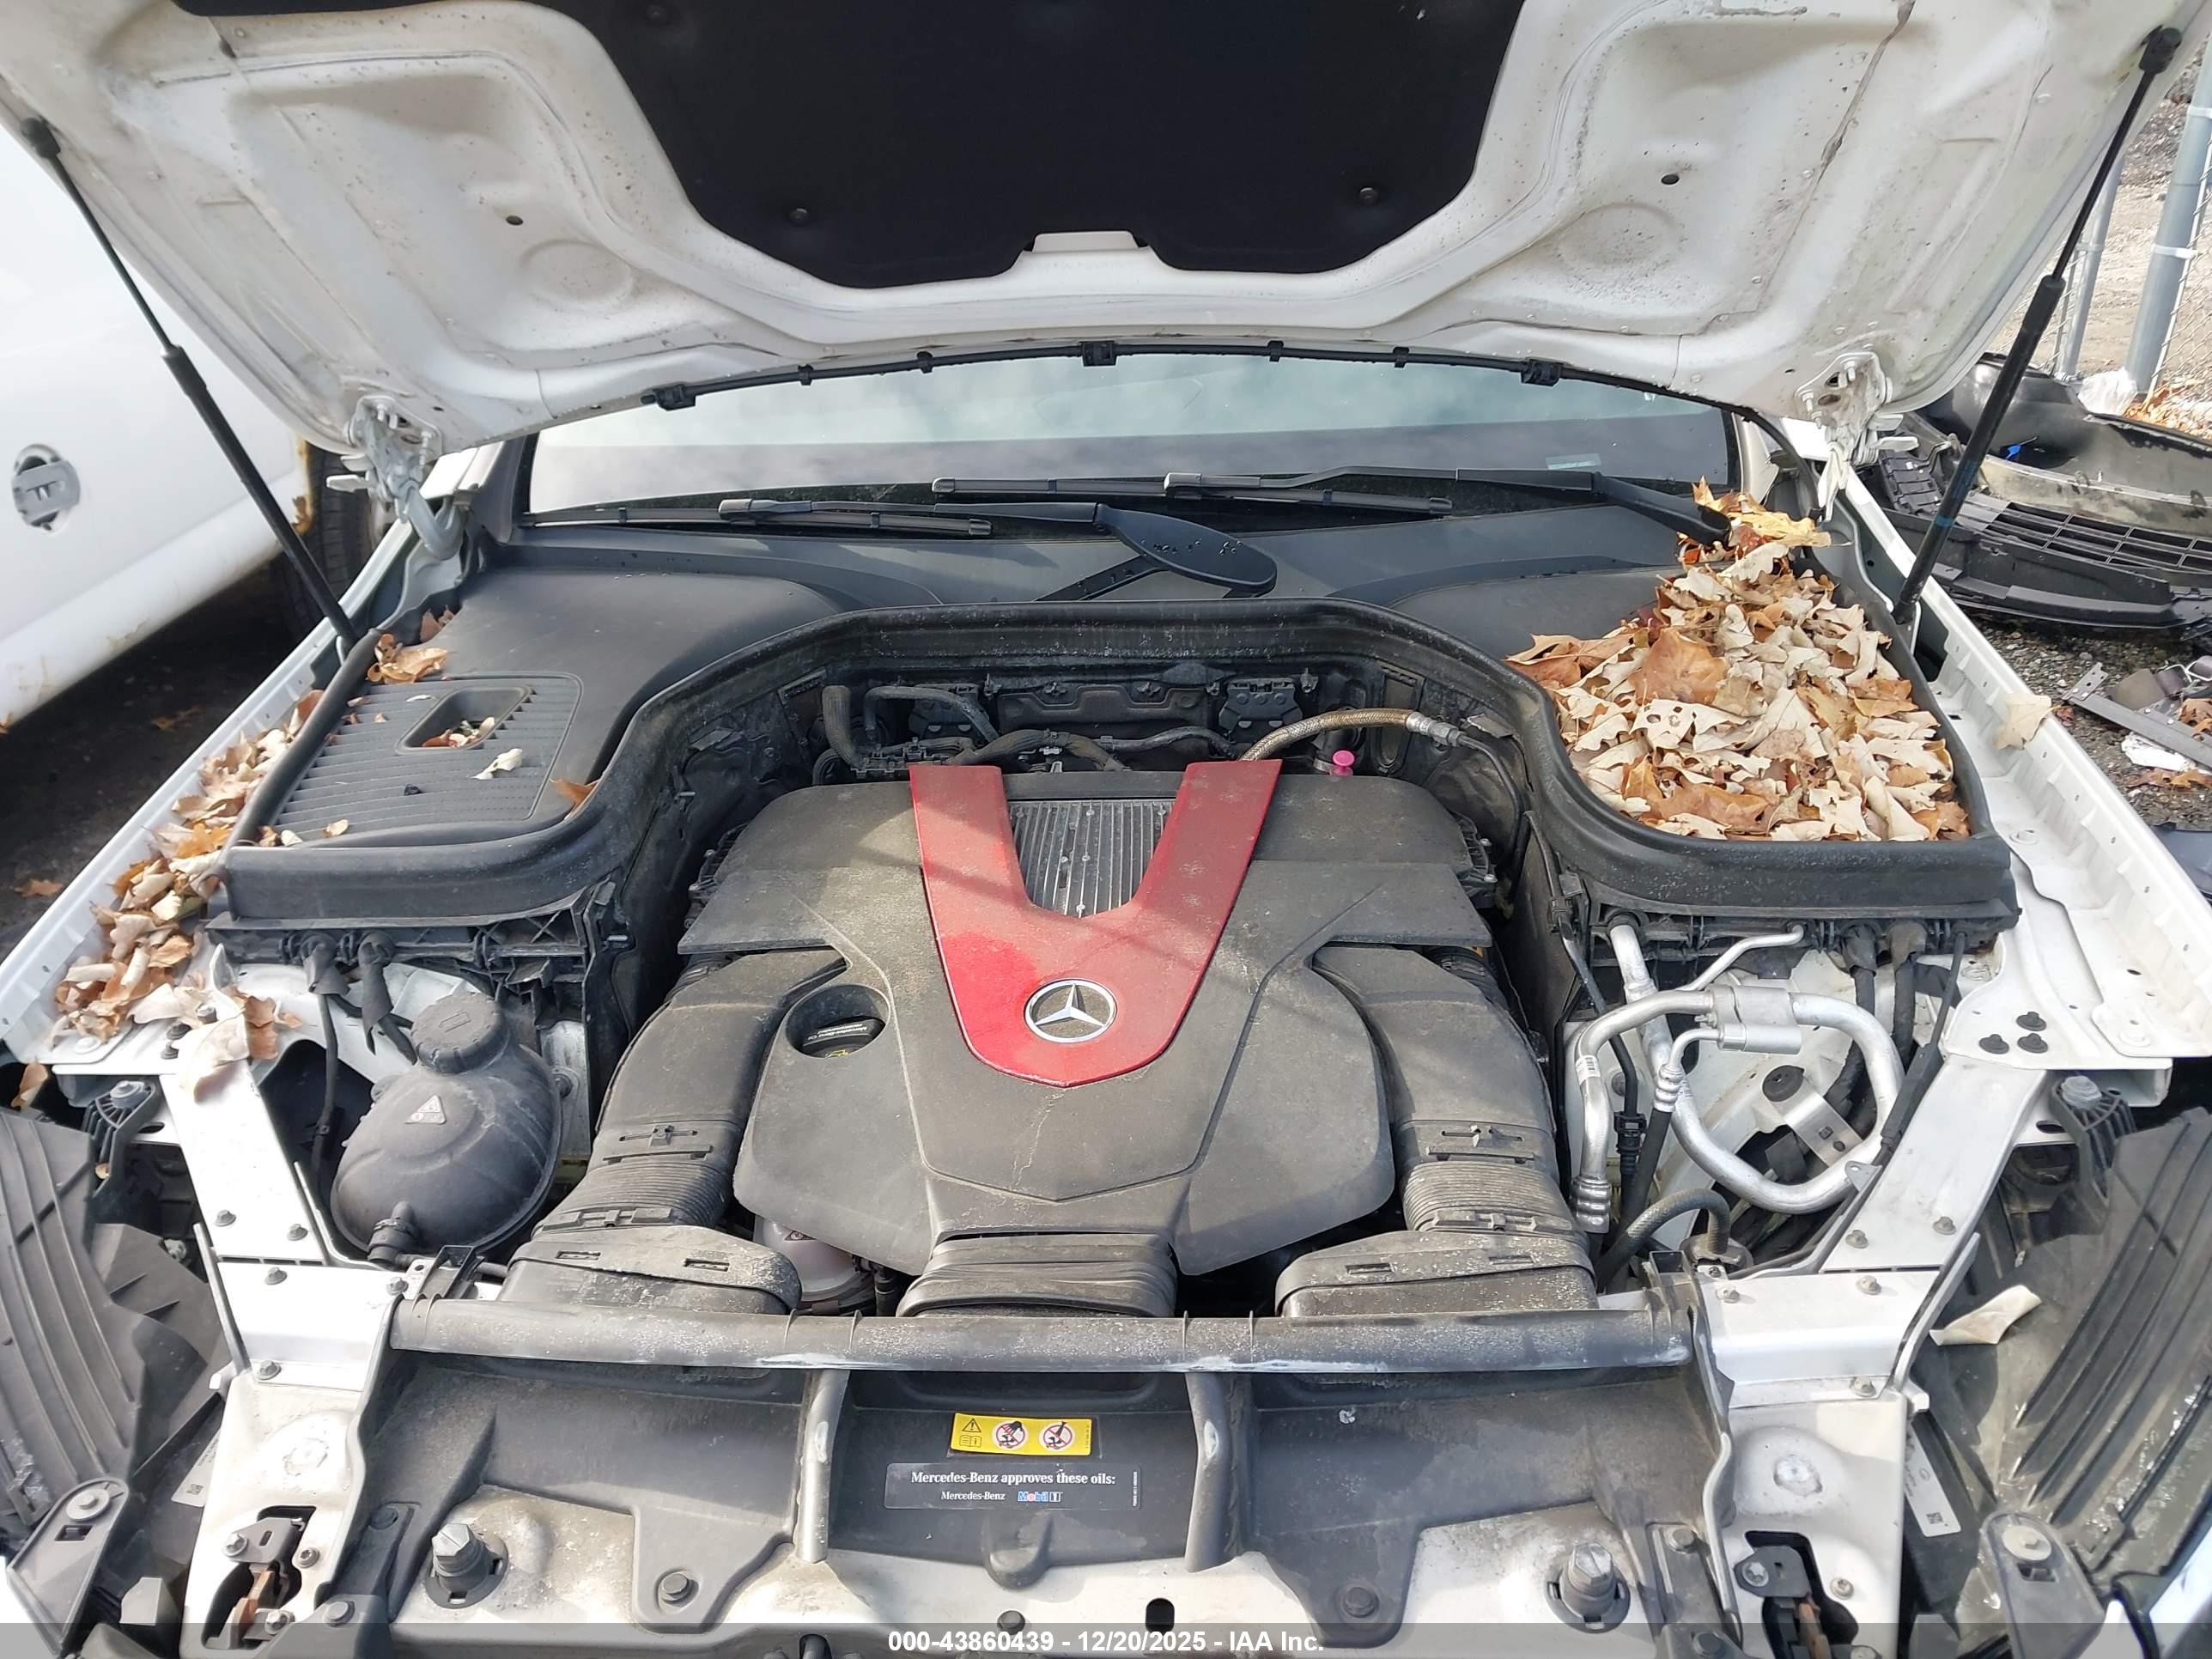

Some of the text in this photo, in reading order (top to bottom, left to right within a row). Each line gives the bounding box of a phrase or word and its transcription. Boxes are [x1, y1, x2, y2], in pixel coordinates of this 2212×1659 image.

[911, 1471, 1116, 1486] Mercedes-Benz approves these oils:
[941, 1491, 1006, 1501] Mercedes-Benz
[1017, 1491, 1049, 1502] Mobil
